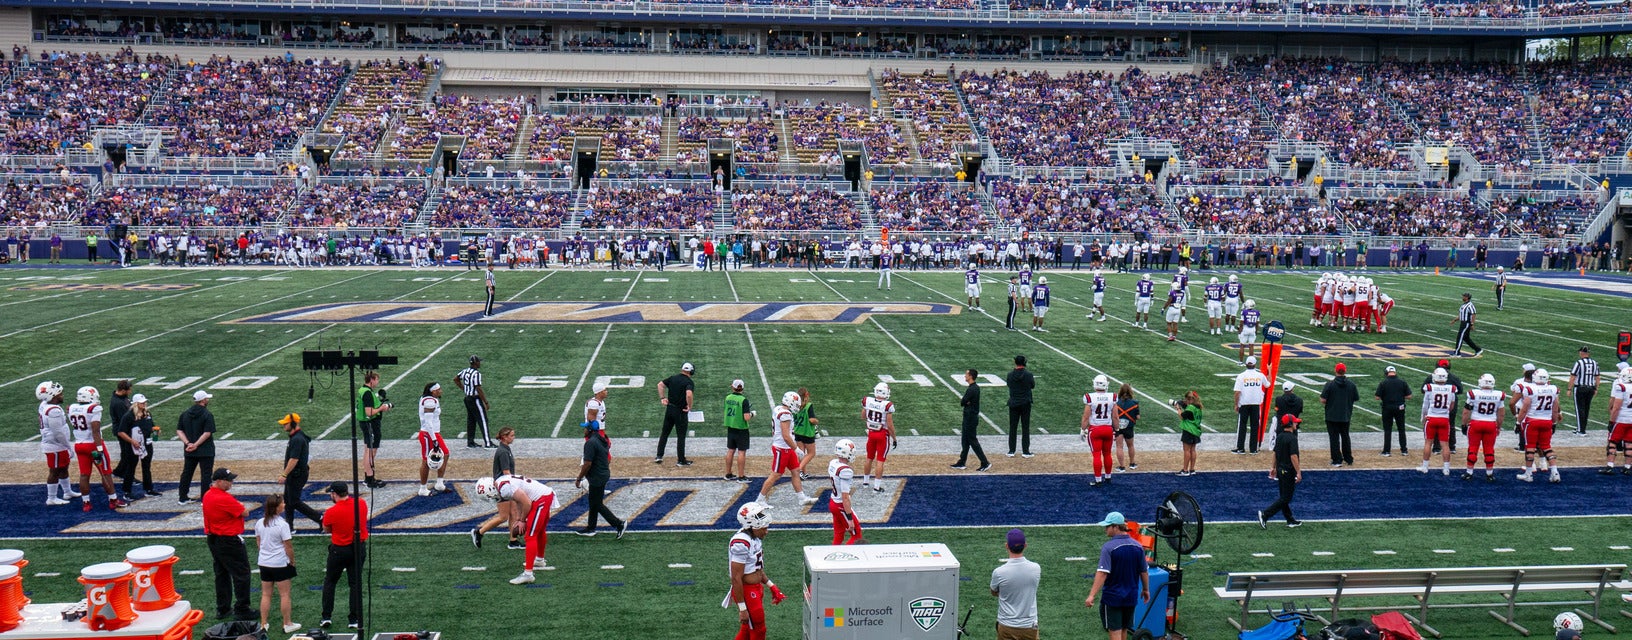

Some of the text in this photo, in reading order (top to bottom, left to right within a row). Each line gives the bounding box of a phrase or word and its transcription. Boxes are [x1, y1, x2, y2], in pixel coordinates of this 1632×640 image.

[1036, 290, 1045, 299] 10
[1208, 290, 1219, 299] 90
[215, 301, 962, 324] JMU
[1617, 332, 1632, 355] 2
[136, 375, 279, 390] 40
[464, 372, 471, 386] S
[513, 374, 646, 389] 50
[877, 373, 1008, 387] 40
[1433, 393, 1449, 409] 81
[1476, 401, 1497, 415] 68
[1535, 395, 1553, 411] 72
[867, 410, 883, 423] 48
[1094, 403, 1109, 419] 41
[69, 414, 89, 431] 33
[136, 570, 151, 588] G
[90, 586, 107, 606] G
[848, 606, 893, 617] Microsoft
[911, 607, 943, 617] MAC
[848, 617, 884, 627] Surface
